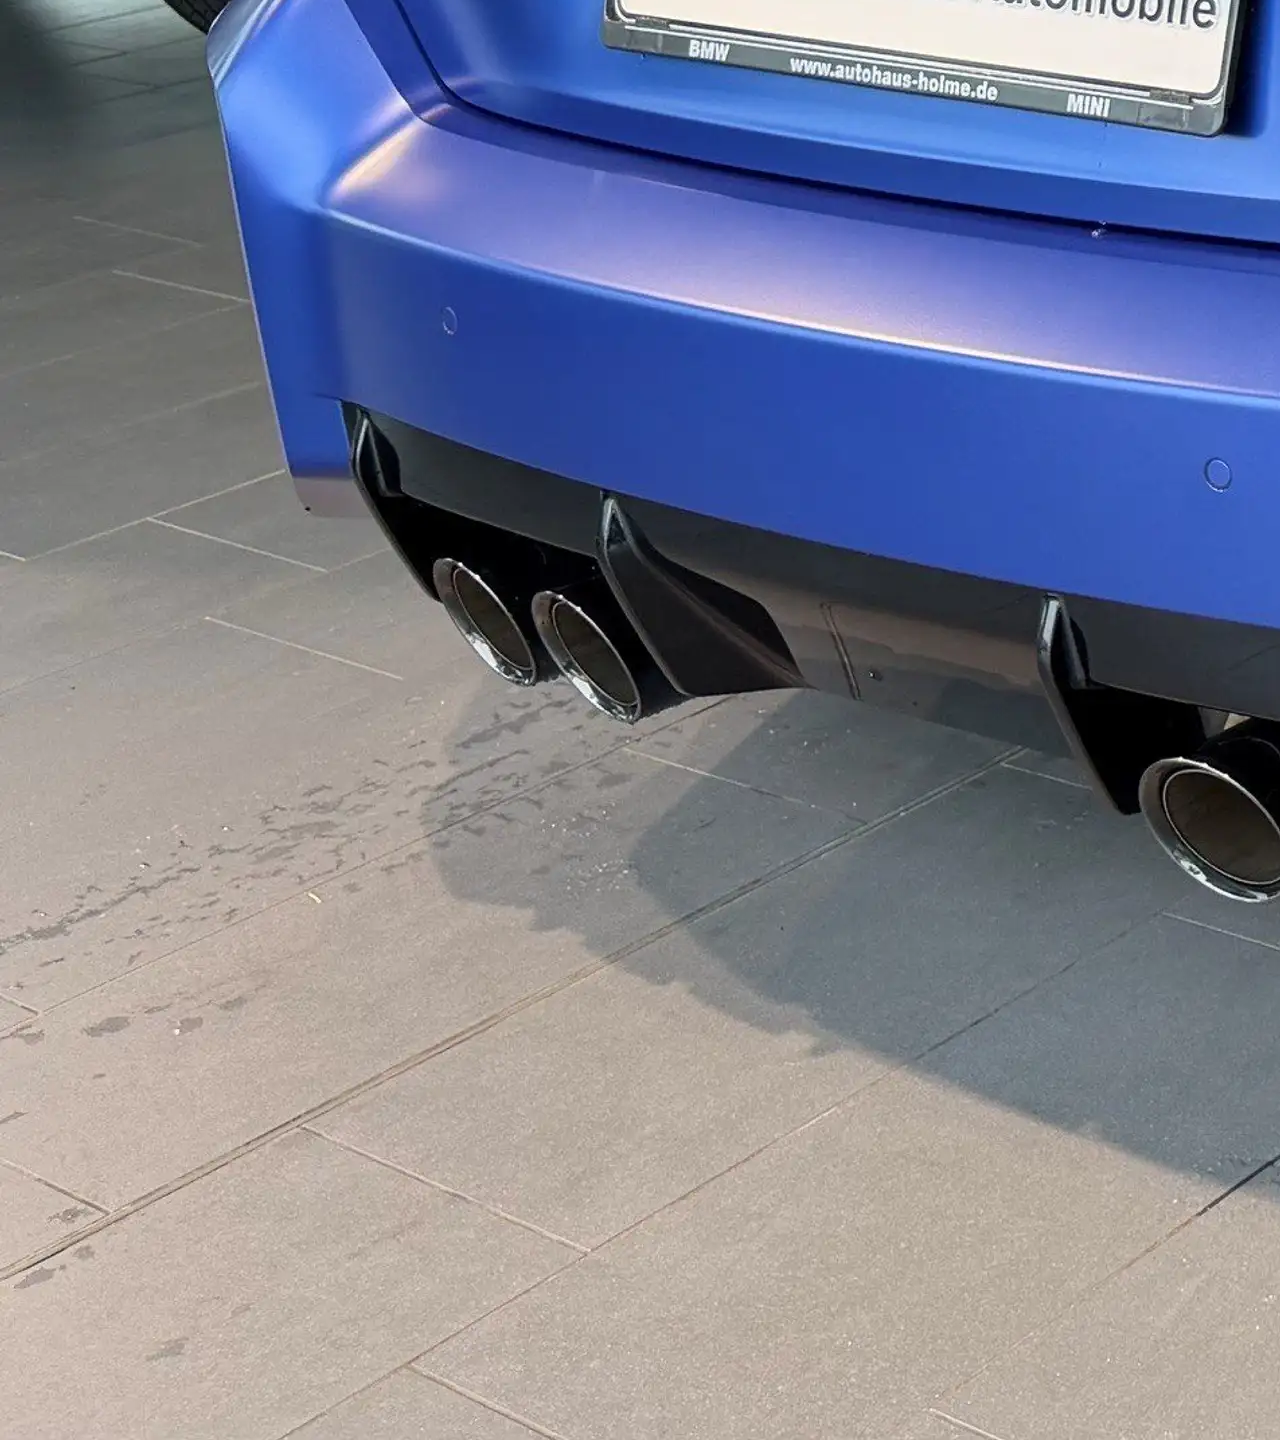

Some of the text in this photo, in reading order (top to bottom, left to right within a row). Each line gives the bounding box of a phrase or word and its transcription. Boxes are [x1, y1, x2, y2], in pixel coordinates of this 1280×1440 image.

[688, 39, 1112, 118] BMW www.autohaus-holme.de MINI
